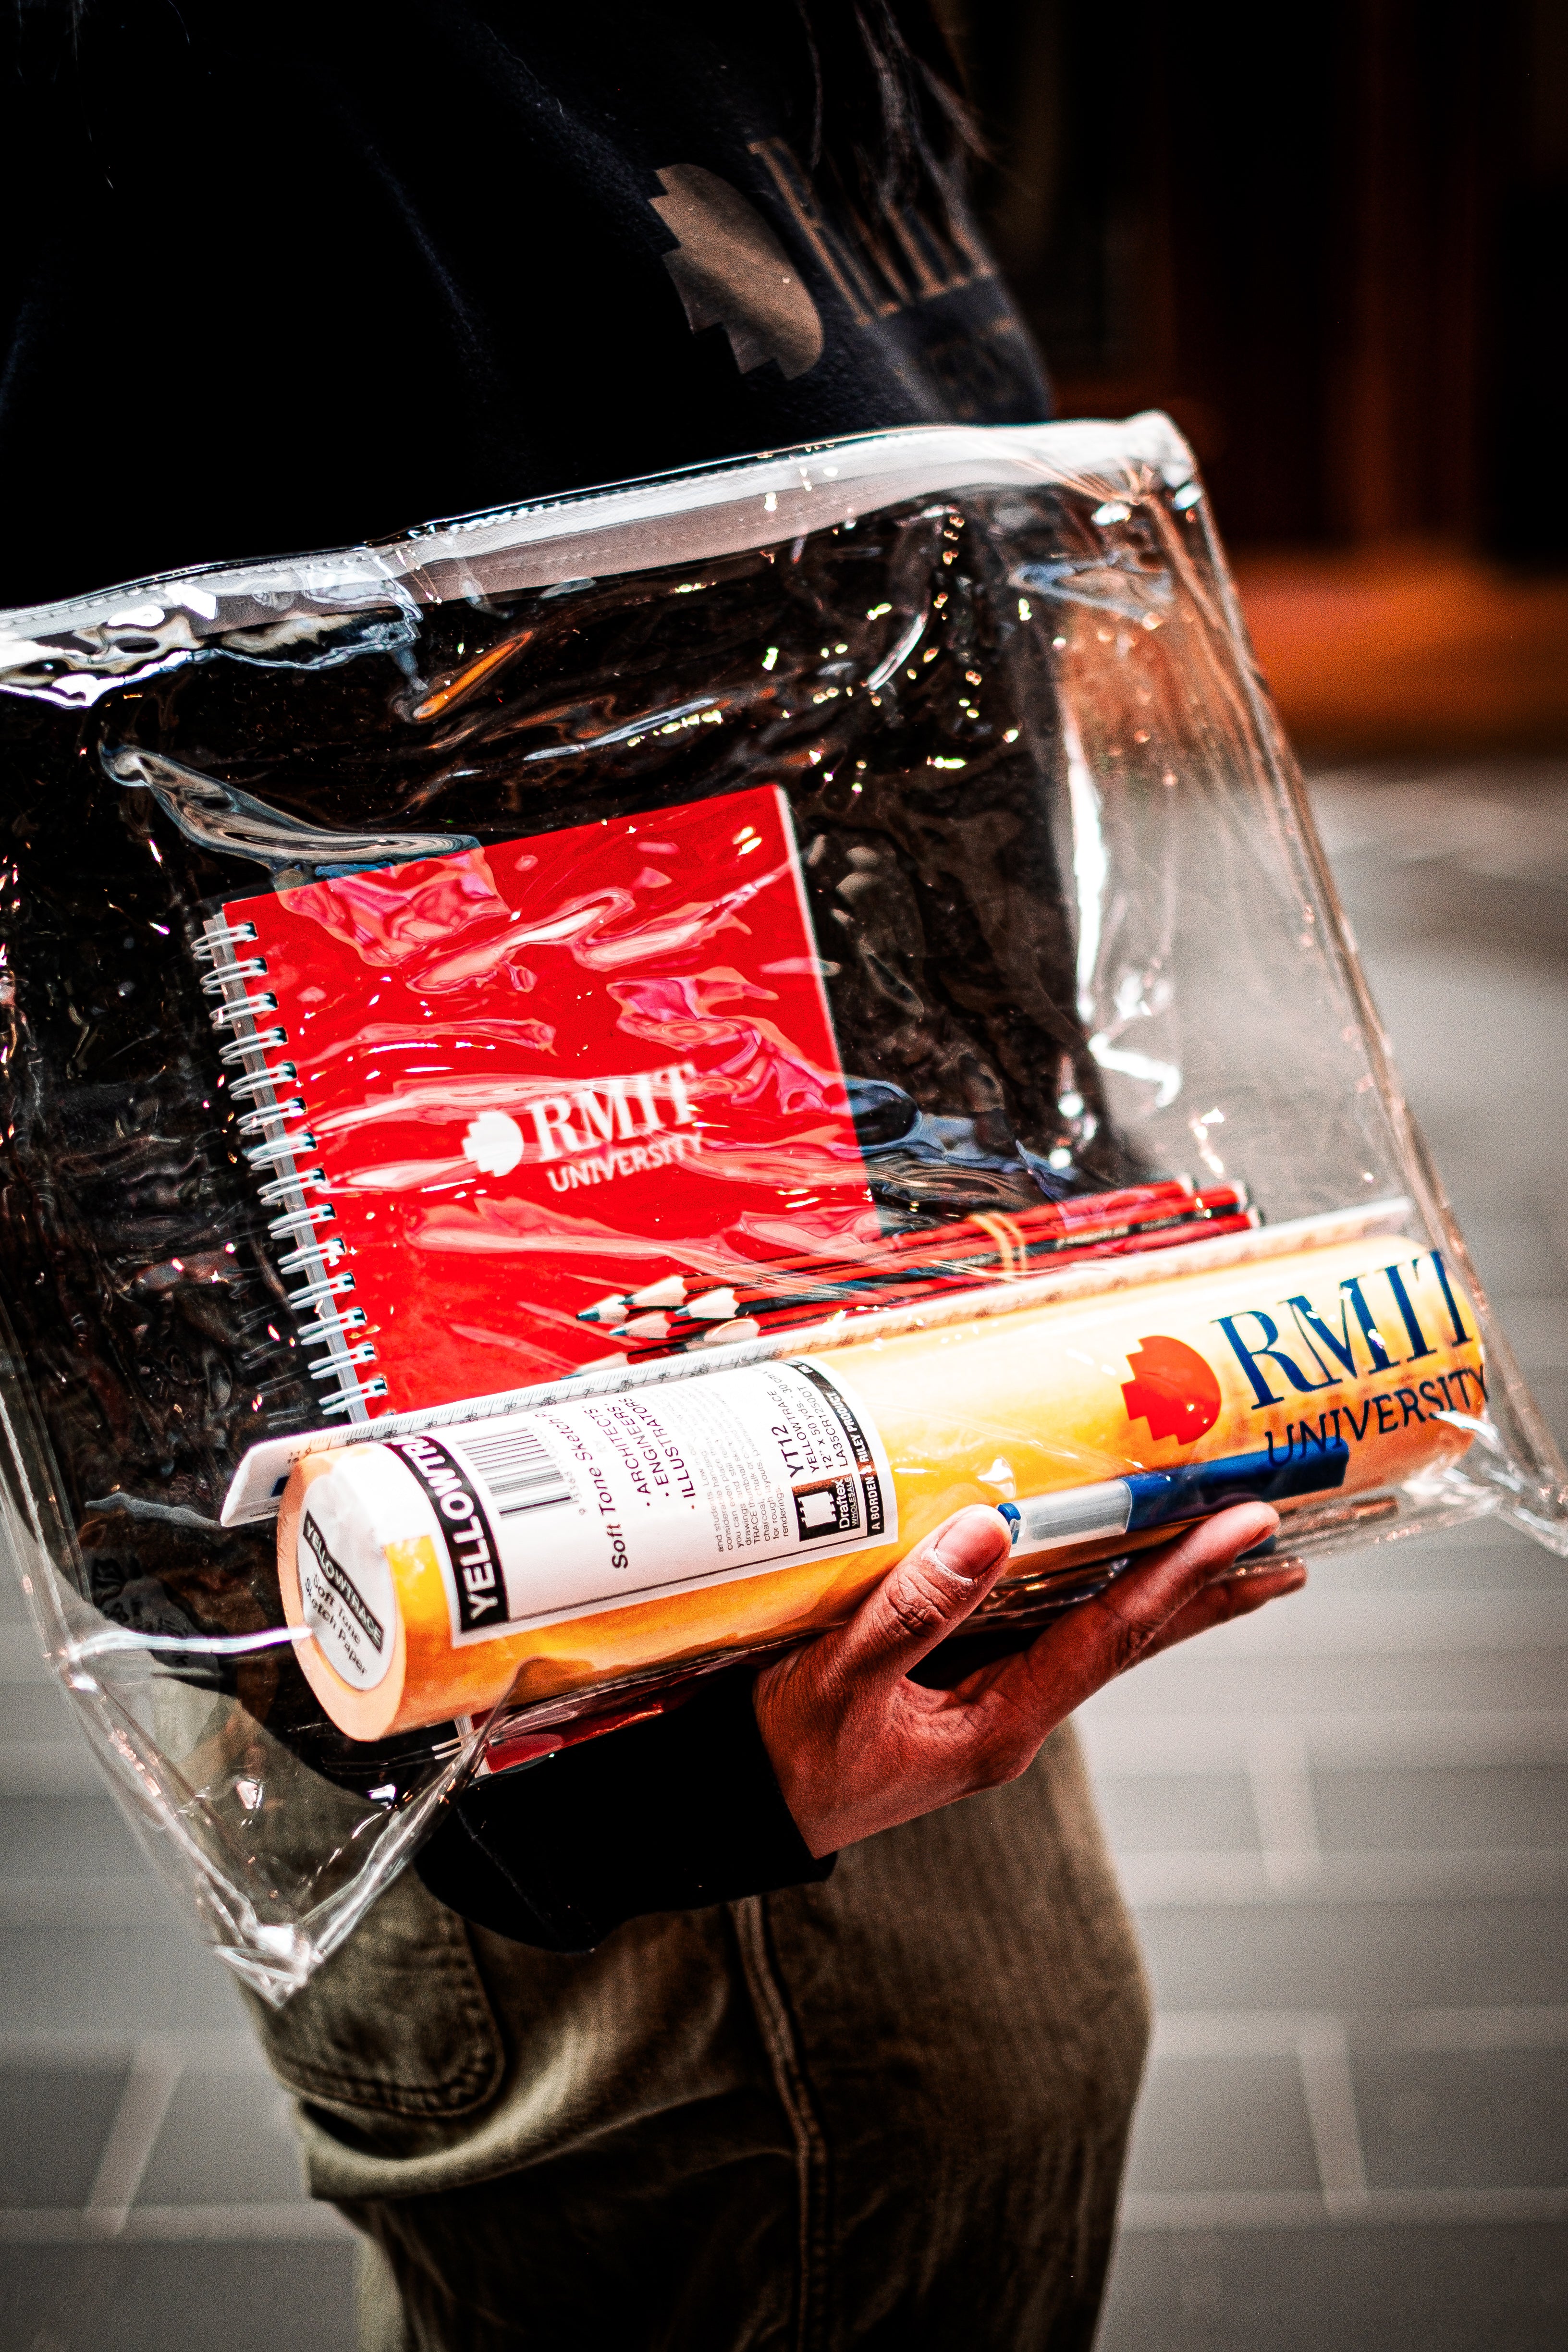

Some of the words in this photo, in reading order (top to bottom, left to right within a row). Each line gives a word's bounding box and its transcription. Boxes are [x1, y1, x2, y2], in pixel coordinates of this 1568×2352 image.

[526, 1061, 698, 1162] RMIT
[547, 1131, 703, 1193] UNIVERSITY
[1210, 1250, 1474, 1411] RMIT
[779, 1384, 793, 1394] 30
[548, 1418, 593, 1461] Sketch
[767, 1390, 819, 1474] YELLOWTRACE
[797, 1386, 848, 1467] LA35CR1250DT
[807, 1423, 821, 1436] 50
[1264, 1364, 1491, 1469] UNIVERSITY
[584, 1408, 651, 1494] ARCHITECTS
[607, 1407, 670, 1486] ENGINEERS
[619, 1398, 696, 1498] ILLUSTRATORS
[714, 1458, 730, 1482] place
[772, 1425, 804, 1478] YT12
[849, 1432, 870, 1461] RILEY
[588, 1467, 616, 1516] Tone
[724, 1485, 736, 1507] even
[736, 1463, 756, 1508] thumbnail
[767, 1495, 779, 1523] rough
[831, 1479, 850, 1529] Draftex
[844, 1477, 860, 1527] WHOLESALE
[865, 1476, 880, 1520] BORDEN
[715, 1490, 733, 1551] considerable
[732, 1510, 740, 1528] can
[739, 1503, 752, 1546] drawings
[751, 1510, 761, 1544] TRACE
[774, 1484, 789, 1538] renderings.
[606, 1523, 628, 1569] Soft
[735, 1530, 744, 1548] you
[306, 1519, 383, 1644] YELLOWTRACE
[313, 1573, 335, 1608] Soft
[338, 1608, 361, 1645] Tone
[338, 1628, 367, 1675] Paper
